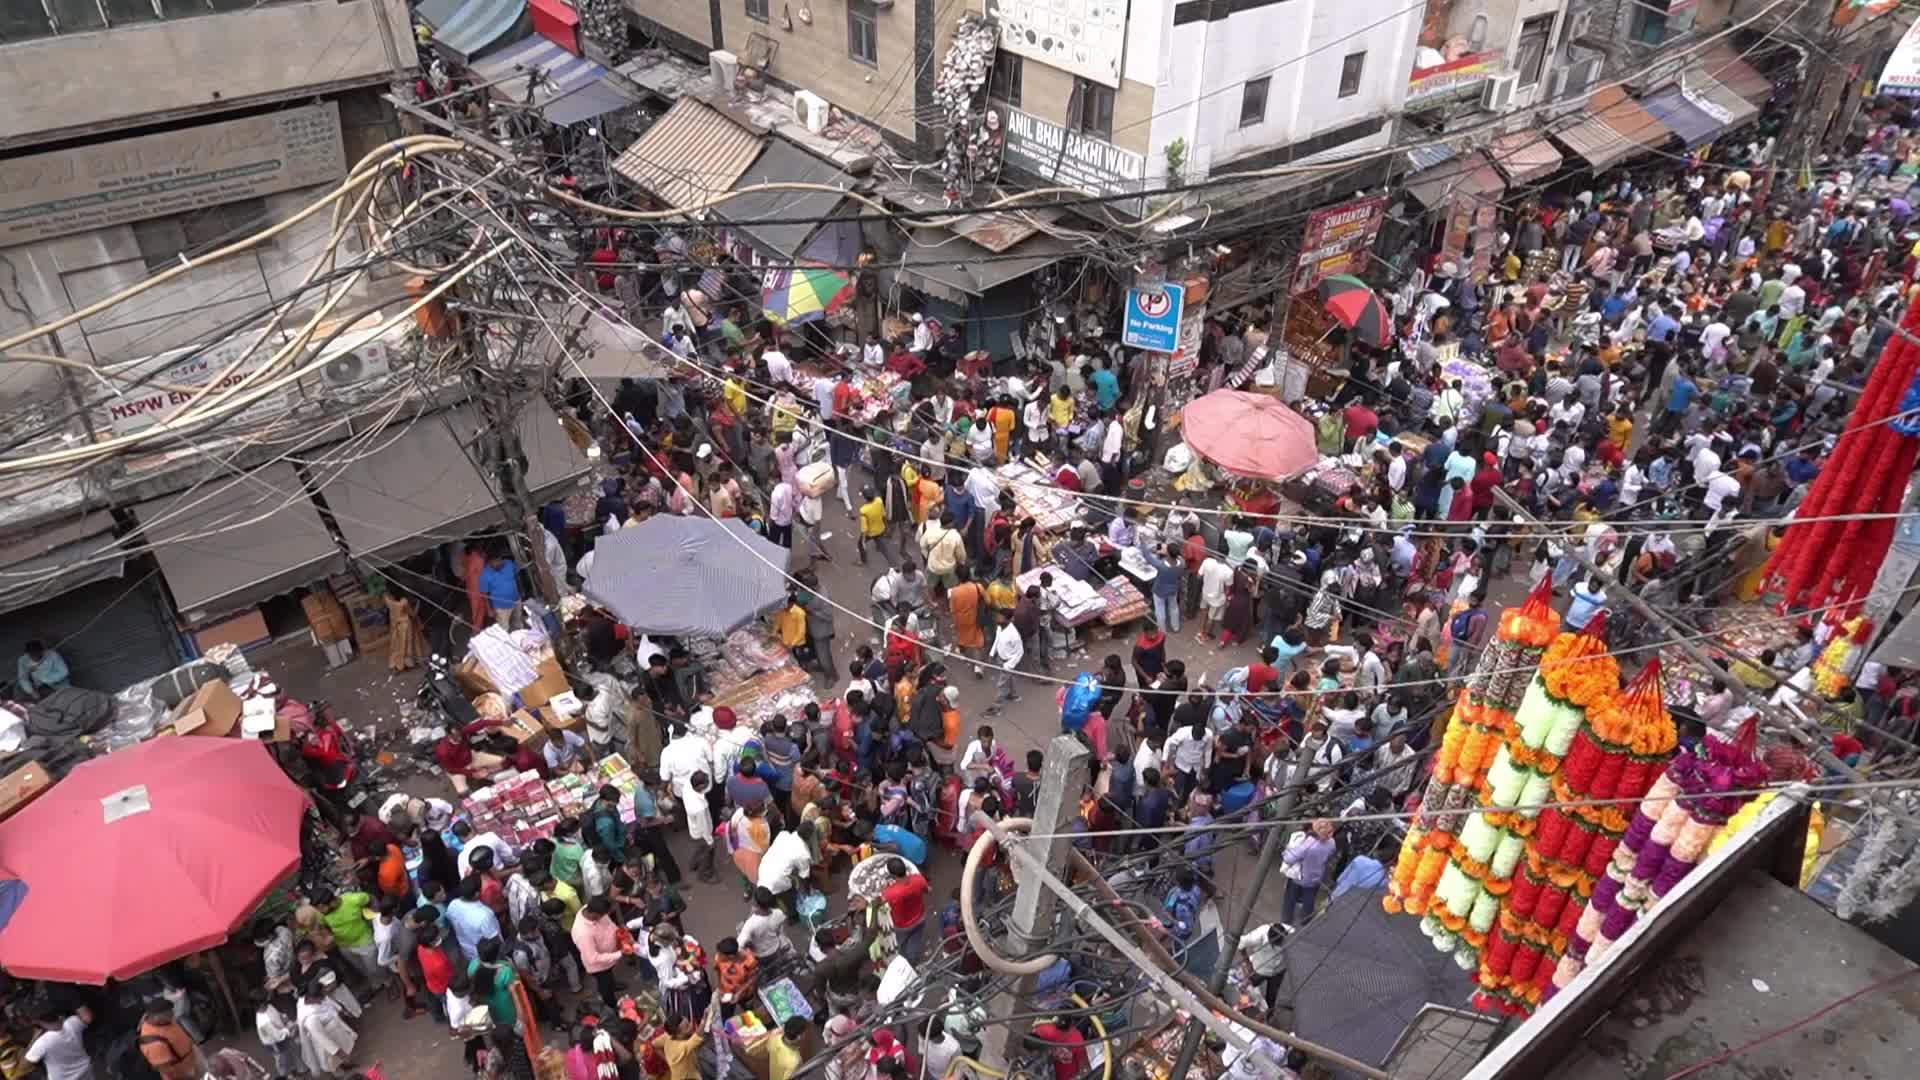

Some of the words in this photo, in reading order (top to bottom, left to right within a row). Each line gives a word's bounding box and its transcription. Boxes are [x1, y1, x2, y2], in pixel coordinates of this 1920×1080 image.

[1008, 110, 1033, 141] ANIL
[1035, 120, 1064, 151] BHAI
[1065, 132, 1103, 167] RAKHI
[1105, 147, 1142, 180] WALA
[1130, 319, 1142, 328] No
[1143, 320, 1174, 335] Parking
[111, 395, 163, 421] MSPW
